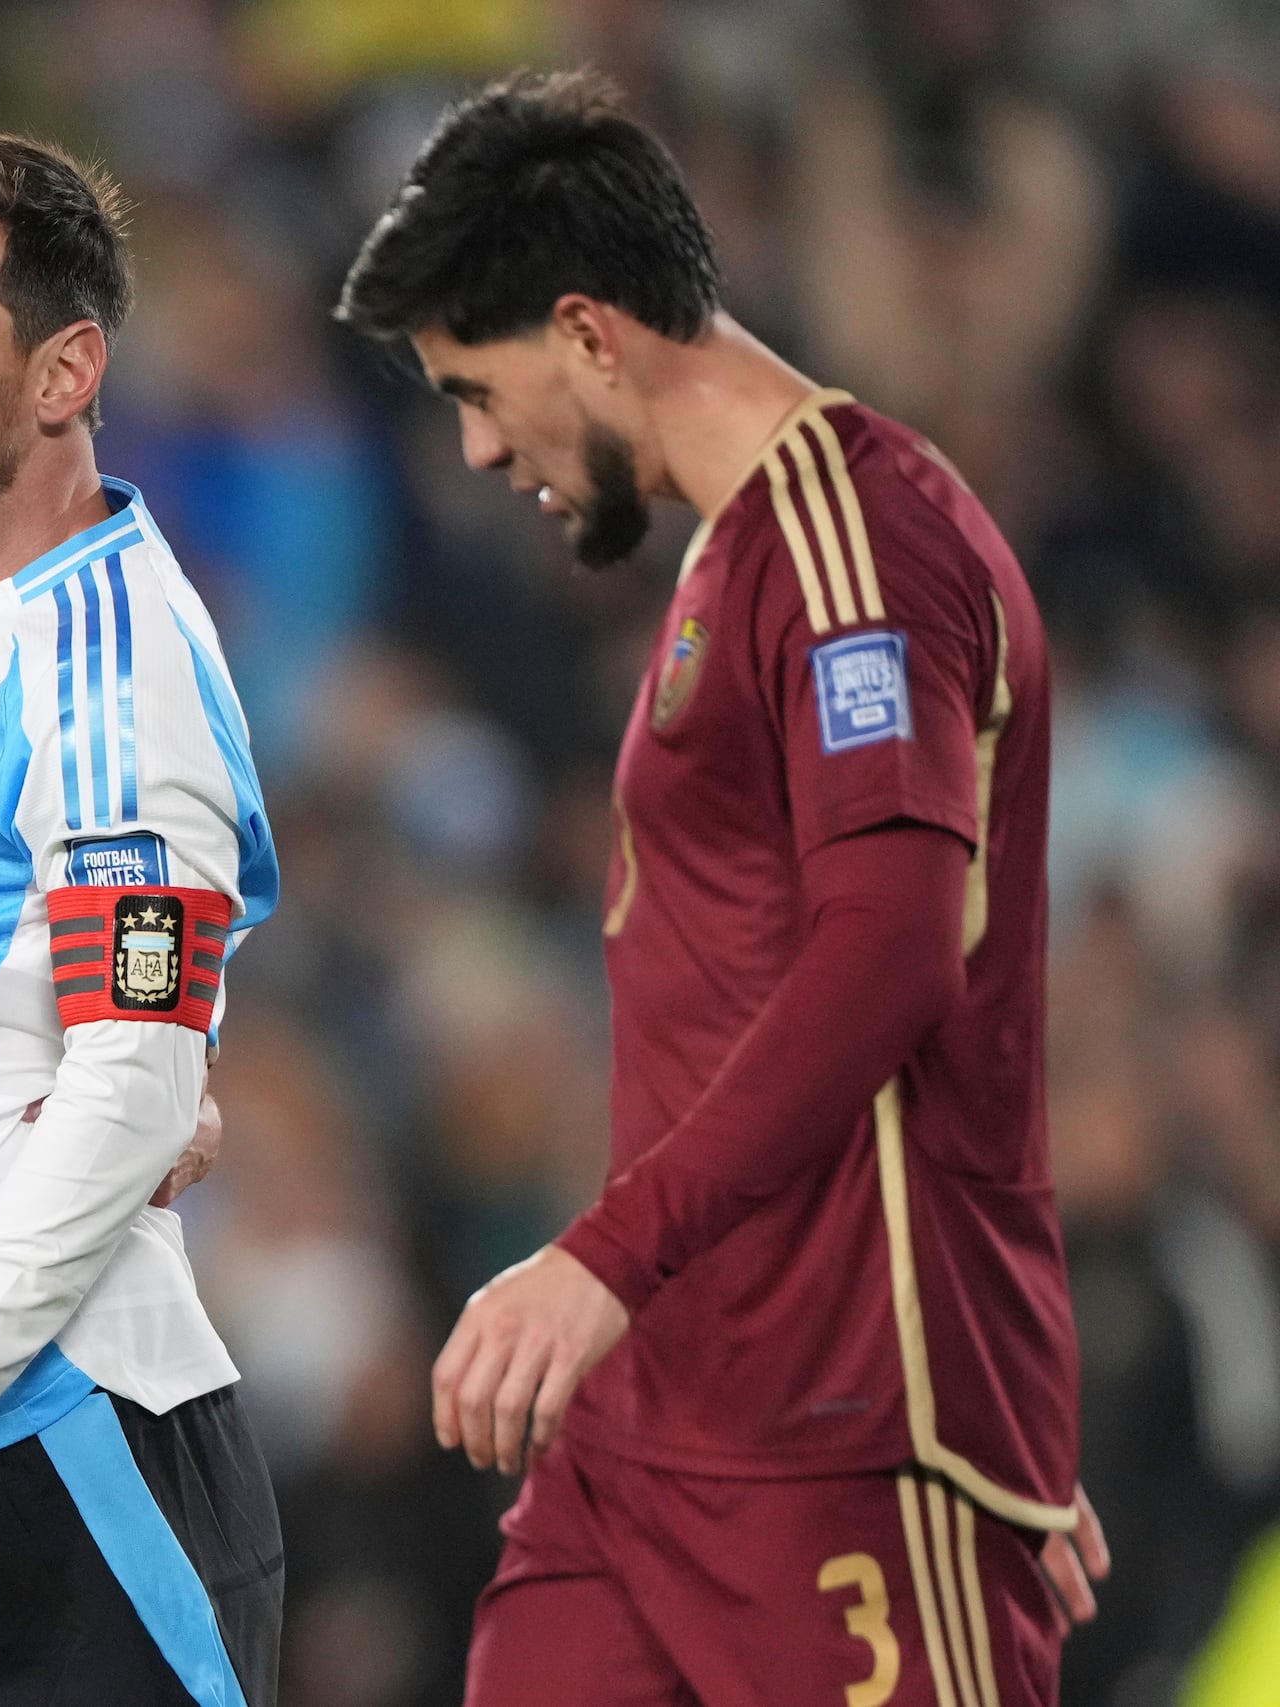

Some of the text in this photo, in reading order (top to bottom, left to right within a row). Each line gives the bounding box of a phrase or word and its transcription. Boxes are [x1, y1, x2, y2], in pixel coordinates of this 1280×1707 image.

[83, 848, 144, 869] FOOTBALL
[86, 865, 146, 887] UNITES
[130, 950, 164, 983] AFA
[816, 1552, 901, 1707] 3
